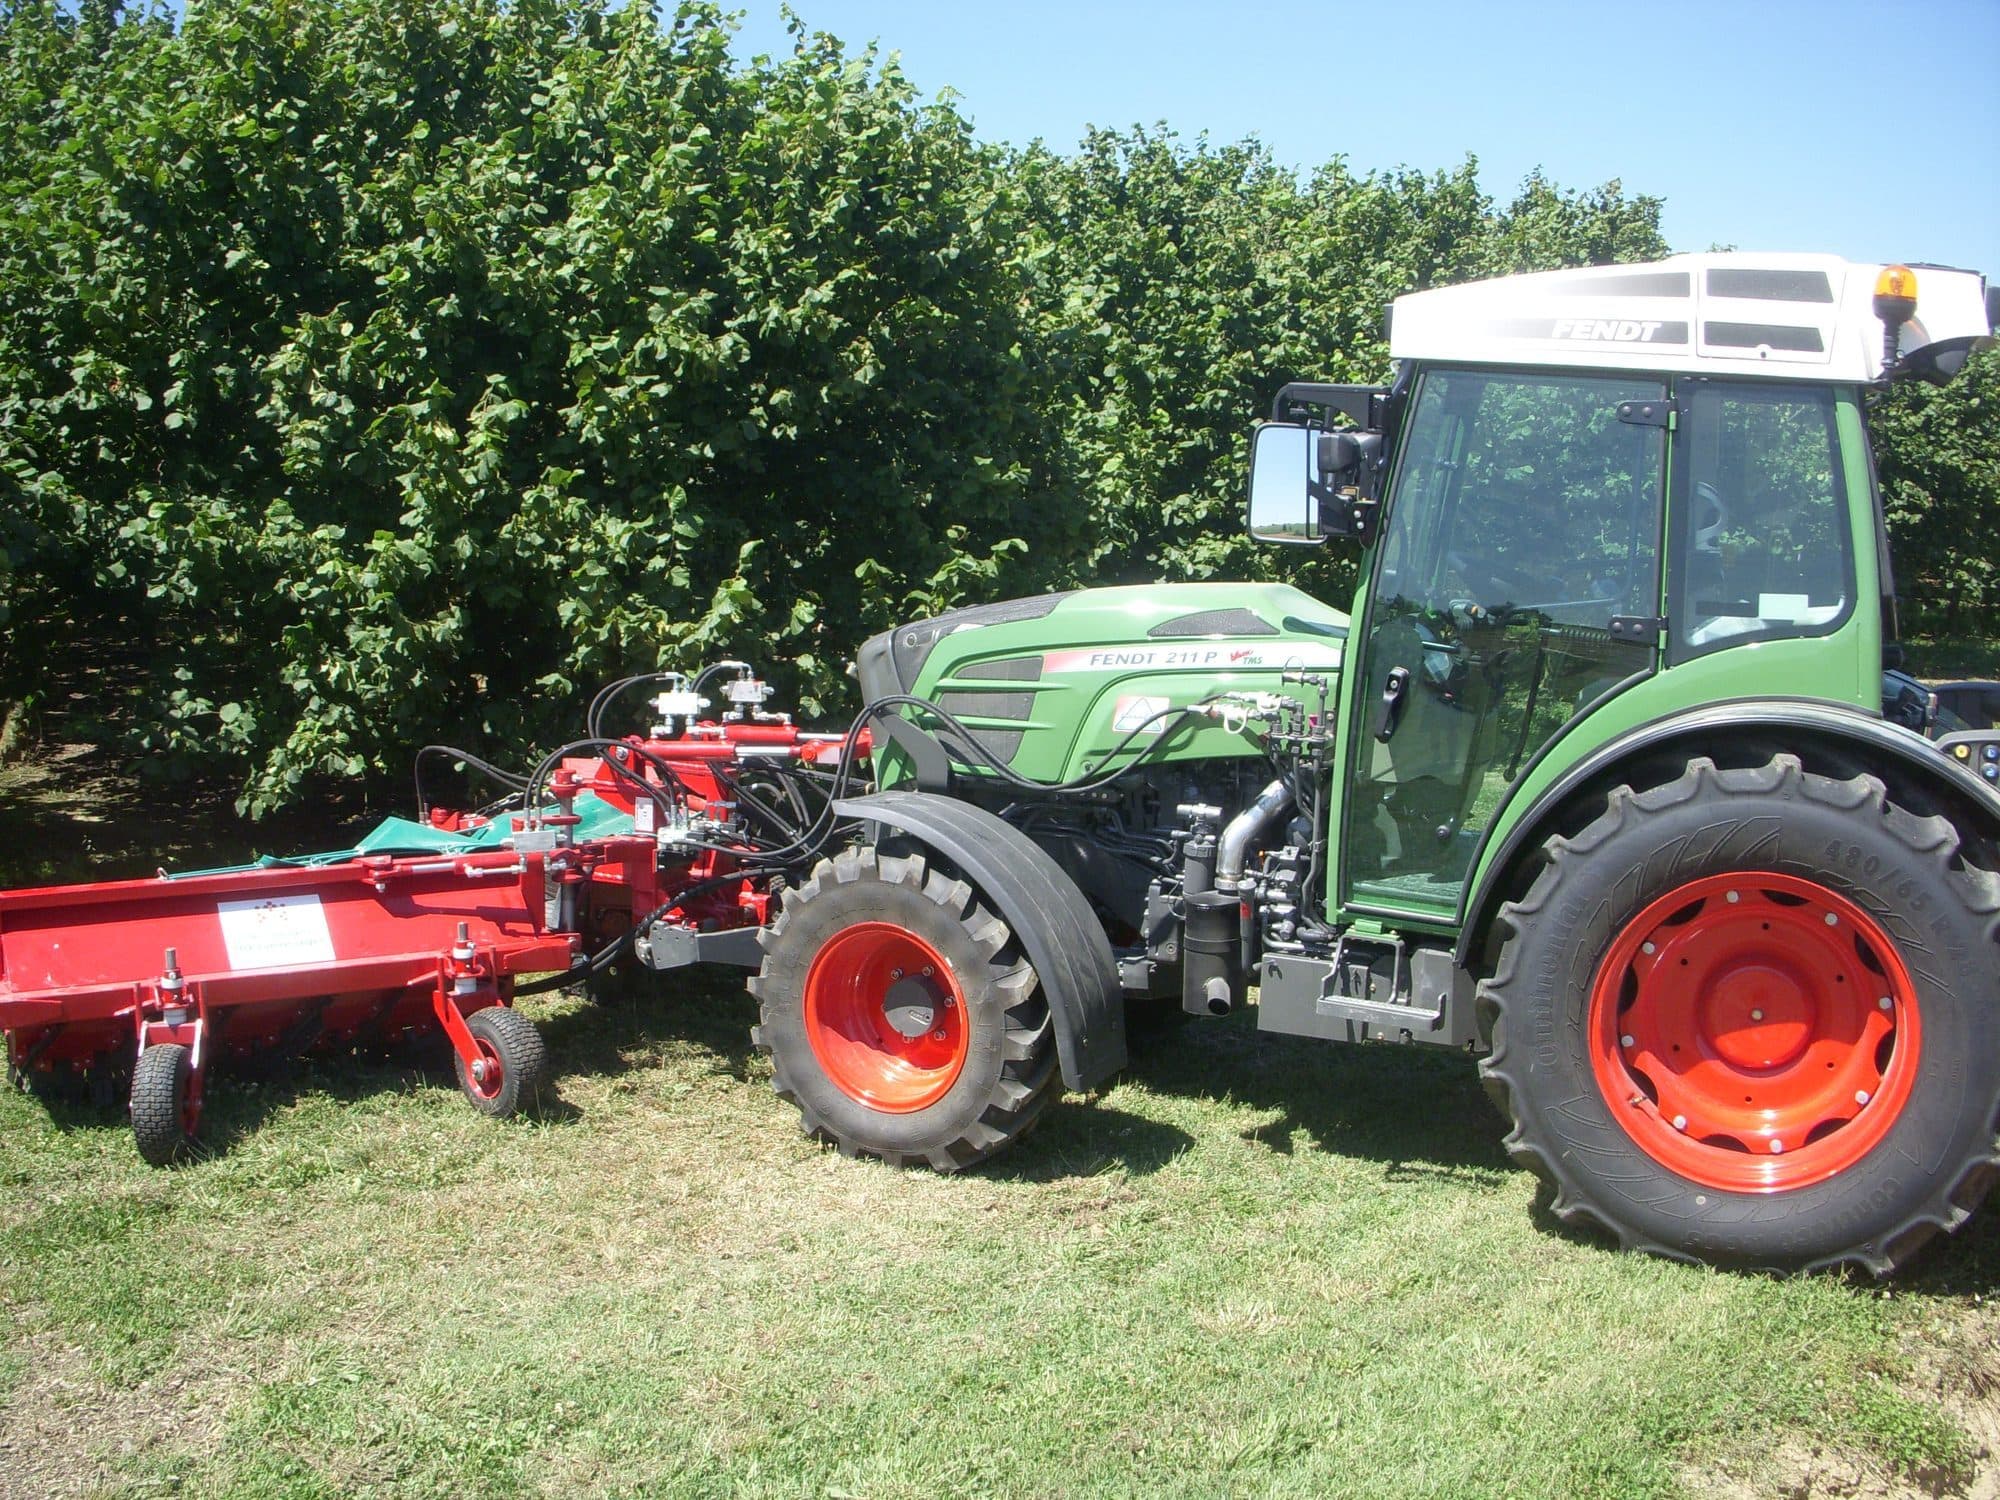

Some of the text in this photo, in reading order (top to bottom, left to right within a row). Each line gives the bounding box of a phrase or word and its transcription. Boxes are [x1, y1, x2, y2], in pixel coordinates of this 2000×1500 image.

[1551, 319, 1663, 342] FENDT
[1089, 651, 1218, 666] FENDT 211 P
[1242, 656, 1263, 665] TMS
